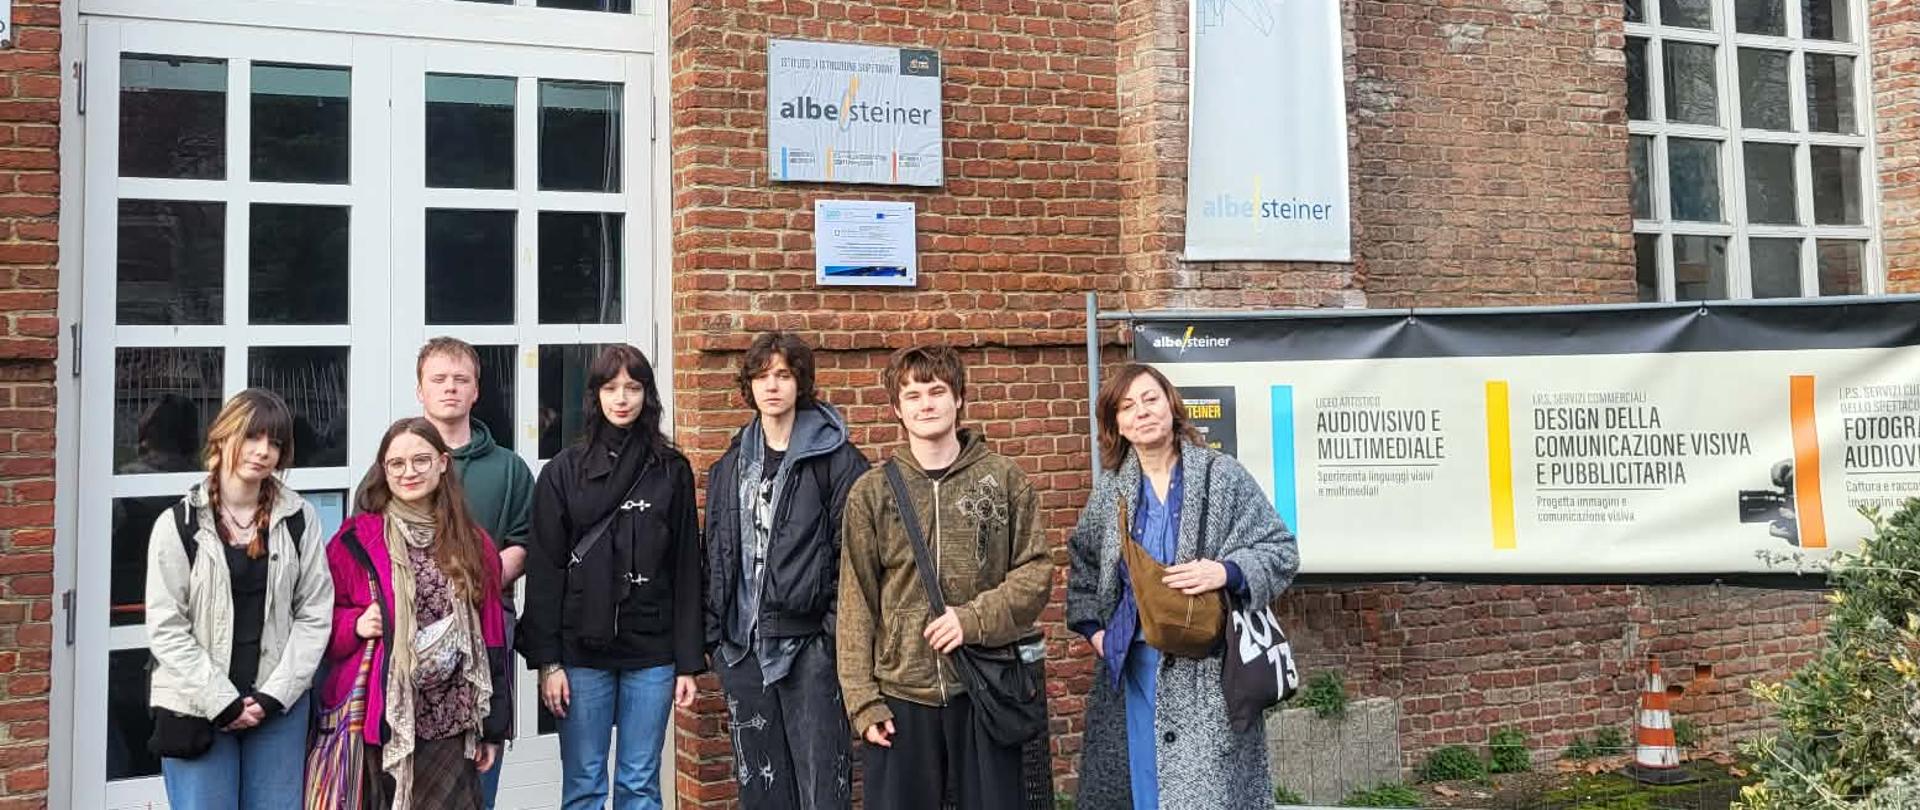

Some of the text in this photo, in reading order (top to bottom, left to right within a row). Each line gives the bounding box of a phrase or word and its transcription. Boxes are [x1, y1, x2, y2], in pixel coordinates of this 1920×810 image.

[780, 96, 932, 125] albe steiner
[1203, 194, 1332, 220] albe steiner
[1153, 334, 1231, 348] albe steiner
[1554, 392, 1585, 404] SERVIZI
[1587, 391, 1647, 403] COMMERCIALI
[1863, 384, 1901, 398] SERVIZI
[1315, 396, 1380, 408] LICEO ARTISTICO
[1841, 401, 1872, 413] DELLO
[1184, 405, 1221, 419] TEINER
[1534, 406, 1662, 430] DESIGN DELLA
[1317, 409, 1442, 433] AUDIOVISIVO E
[1318, 437, 1446, 459] MULTIMEDIALE
[1535, 432, 1752, 457] COMUNICAZIONE VISIVA
[1318, 469, 1434, 485] Sperimenta linguaggi visivi
[1537, 461, 1687, 485] E PUBBLICITARIA
[1318, 485, 1379, 497] e multimediali
[1846, 480, 1881, 492] Cattura
[1891, 481, 1920, 492] racco
[1537, 496, 1575, 509] Progetta
[1577, 495, 1620, 509] immagini
[1538, 510, 1634, 521] comunicazione visiva
